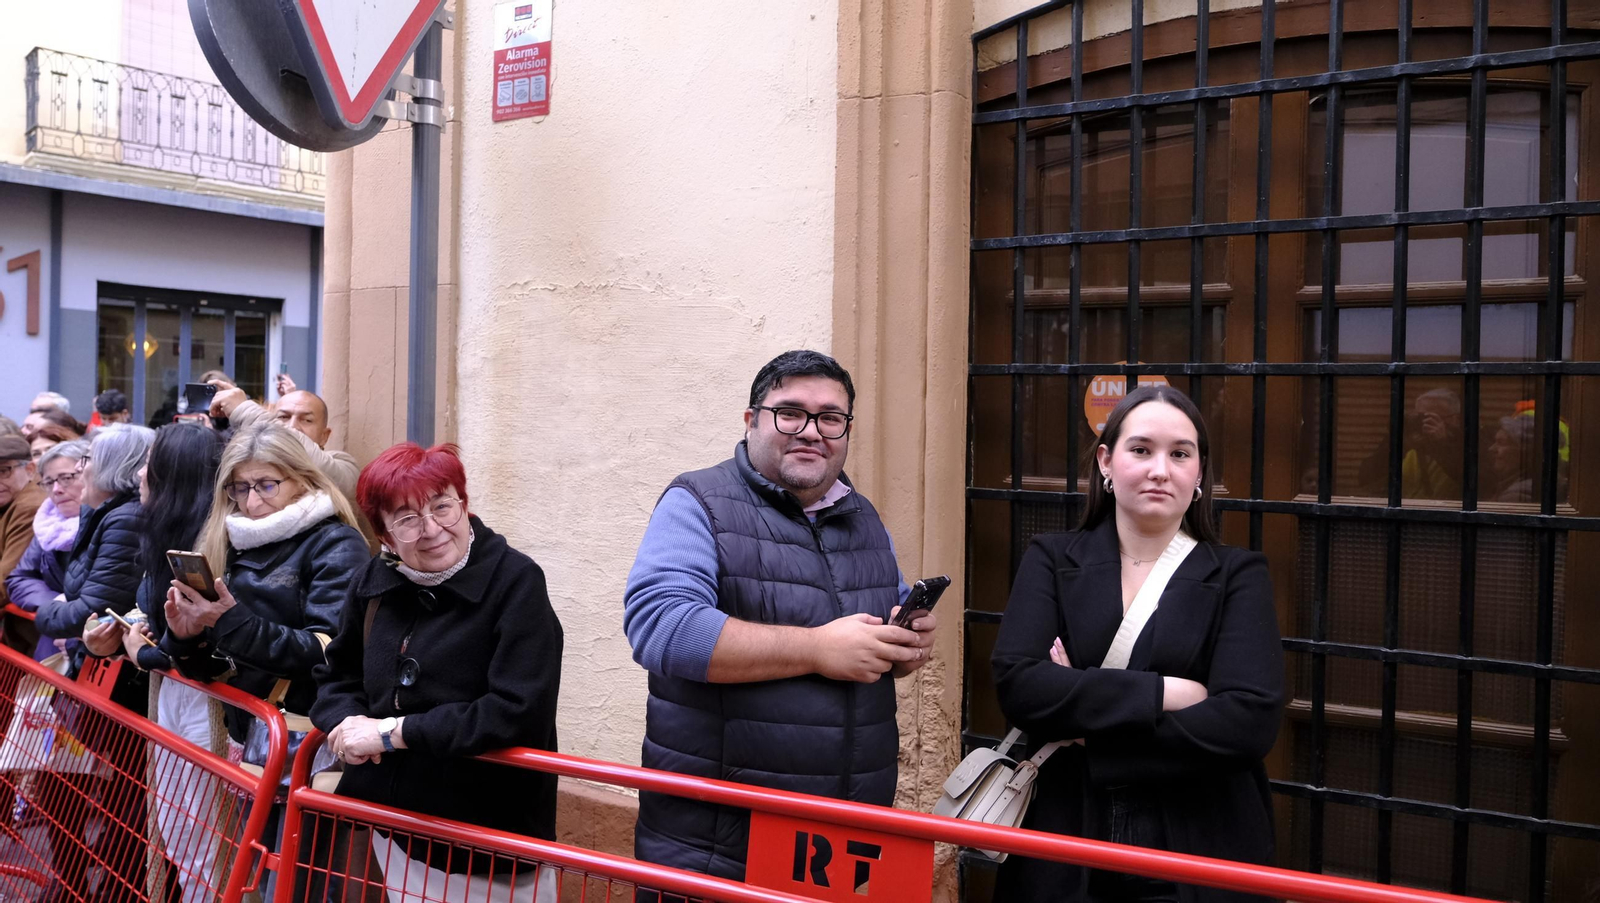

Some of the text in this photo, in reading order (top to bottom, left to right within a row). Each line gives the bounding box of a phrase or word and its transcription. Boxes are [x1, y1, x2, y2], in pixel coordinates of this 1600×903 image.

[506, 47, 539, 61] Alarma
[498, 57, 547, 74] Zerovision
[791, 830, 882, 897] RT
